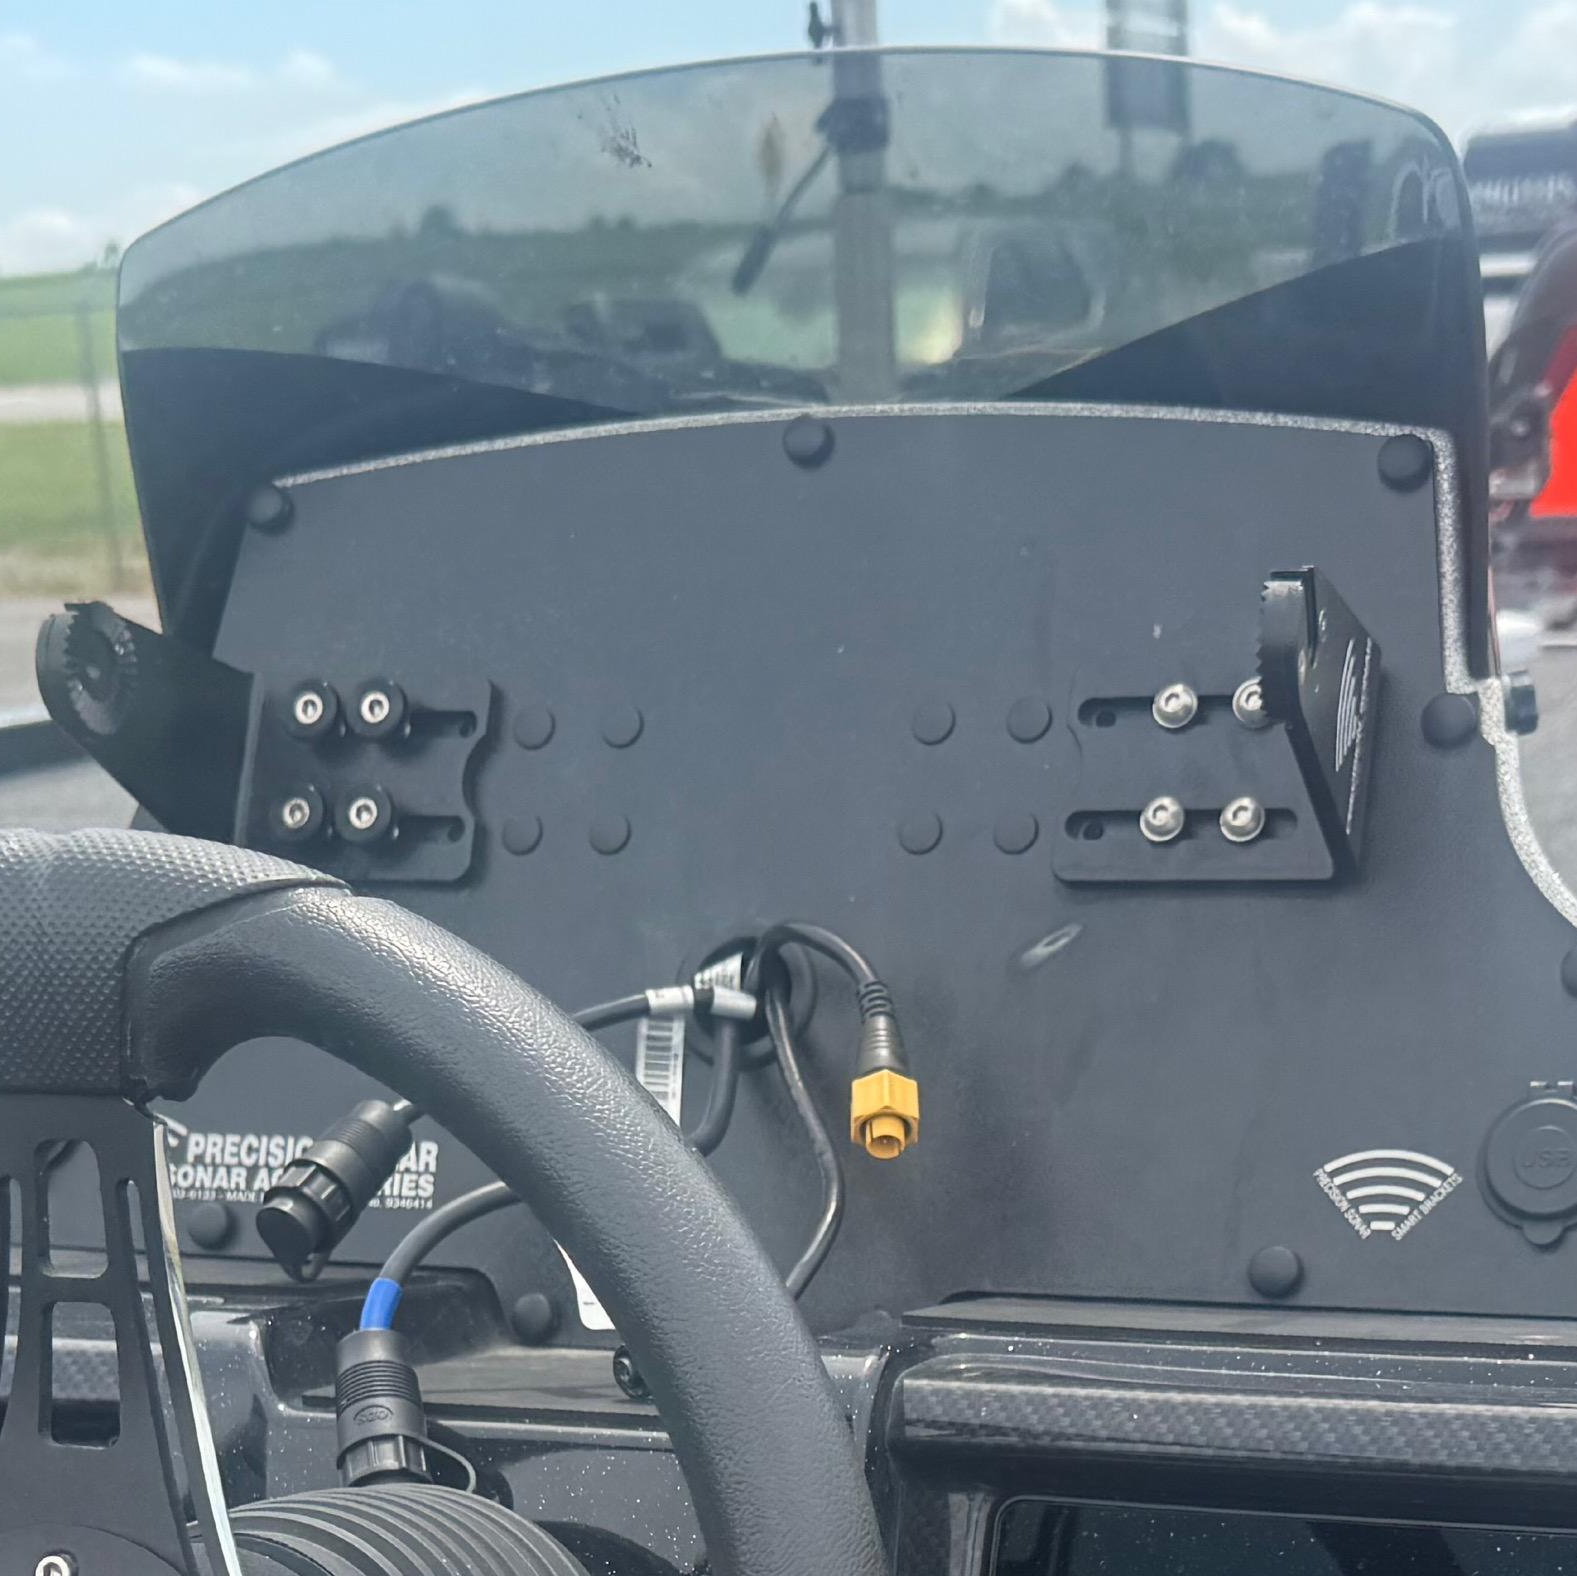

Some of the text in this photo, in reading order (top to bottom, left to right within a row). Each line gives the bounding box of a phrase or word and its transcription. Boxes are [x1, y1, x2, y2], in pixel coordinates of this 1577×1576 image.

[187, 1132, 314, 1167] PRECISI
[1391, 1173, 1463, 1240] SMART BRACKETS
